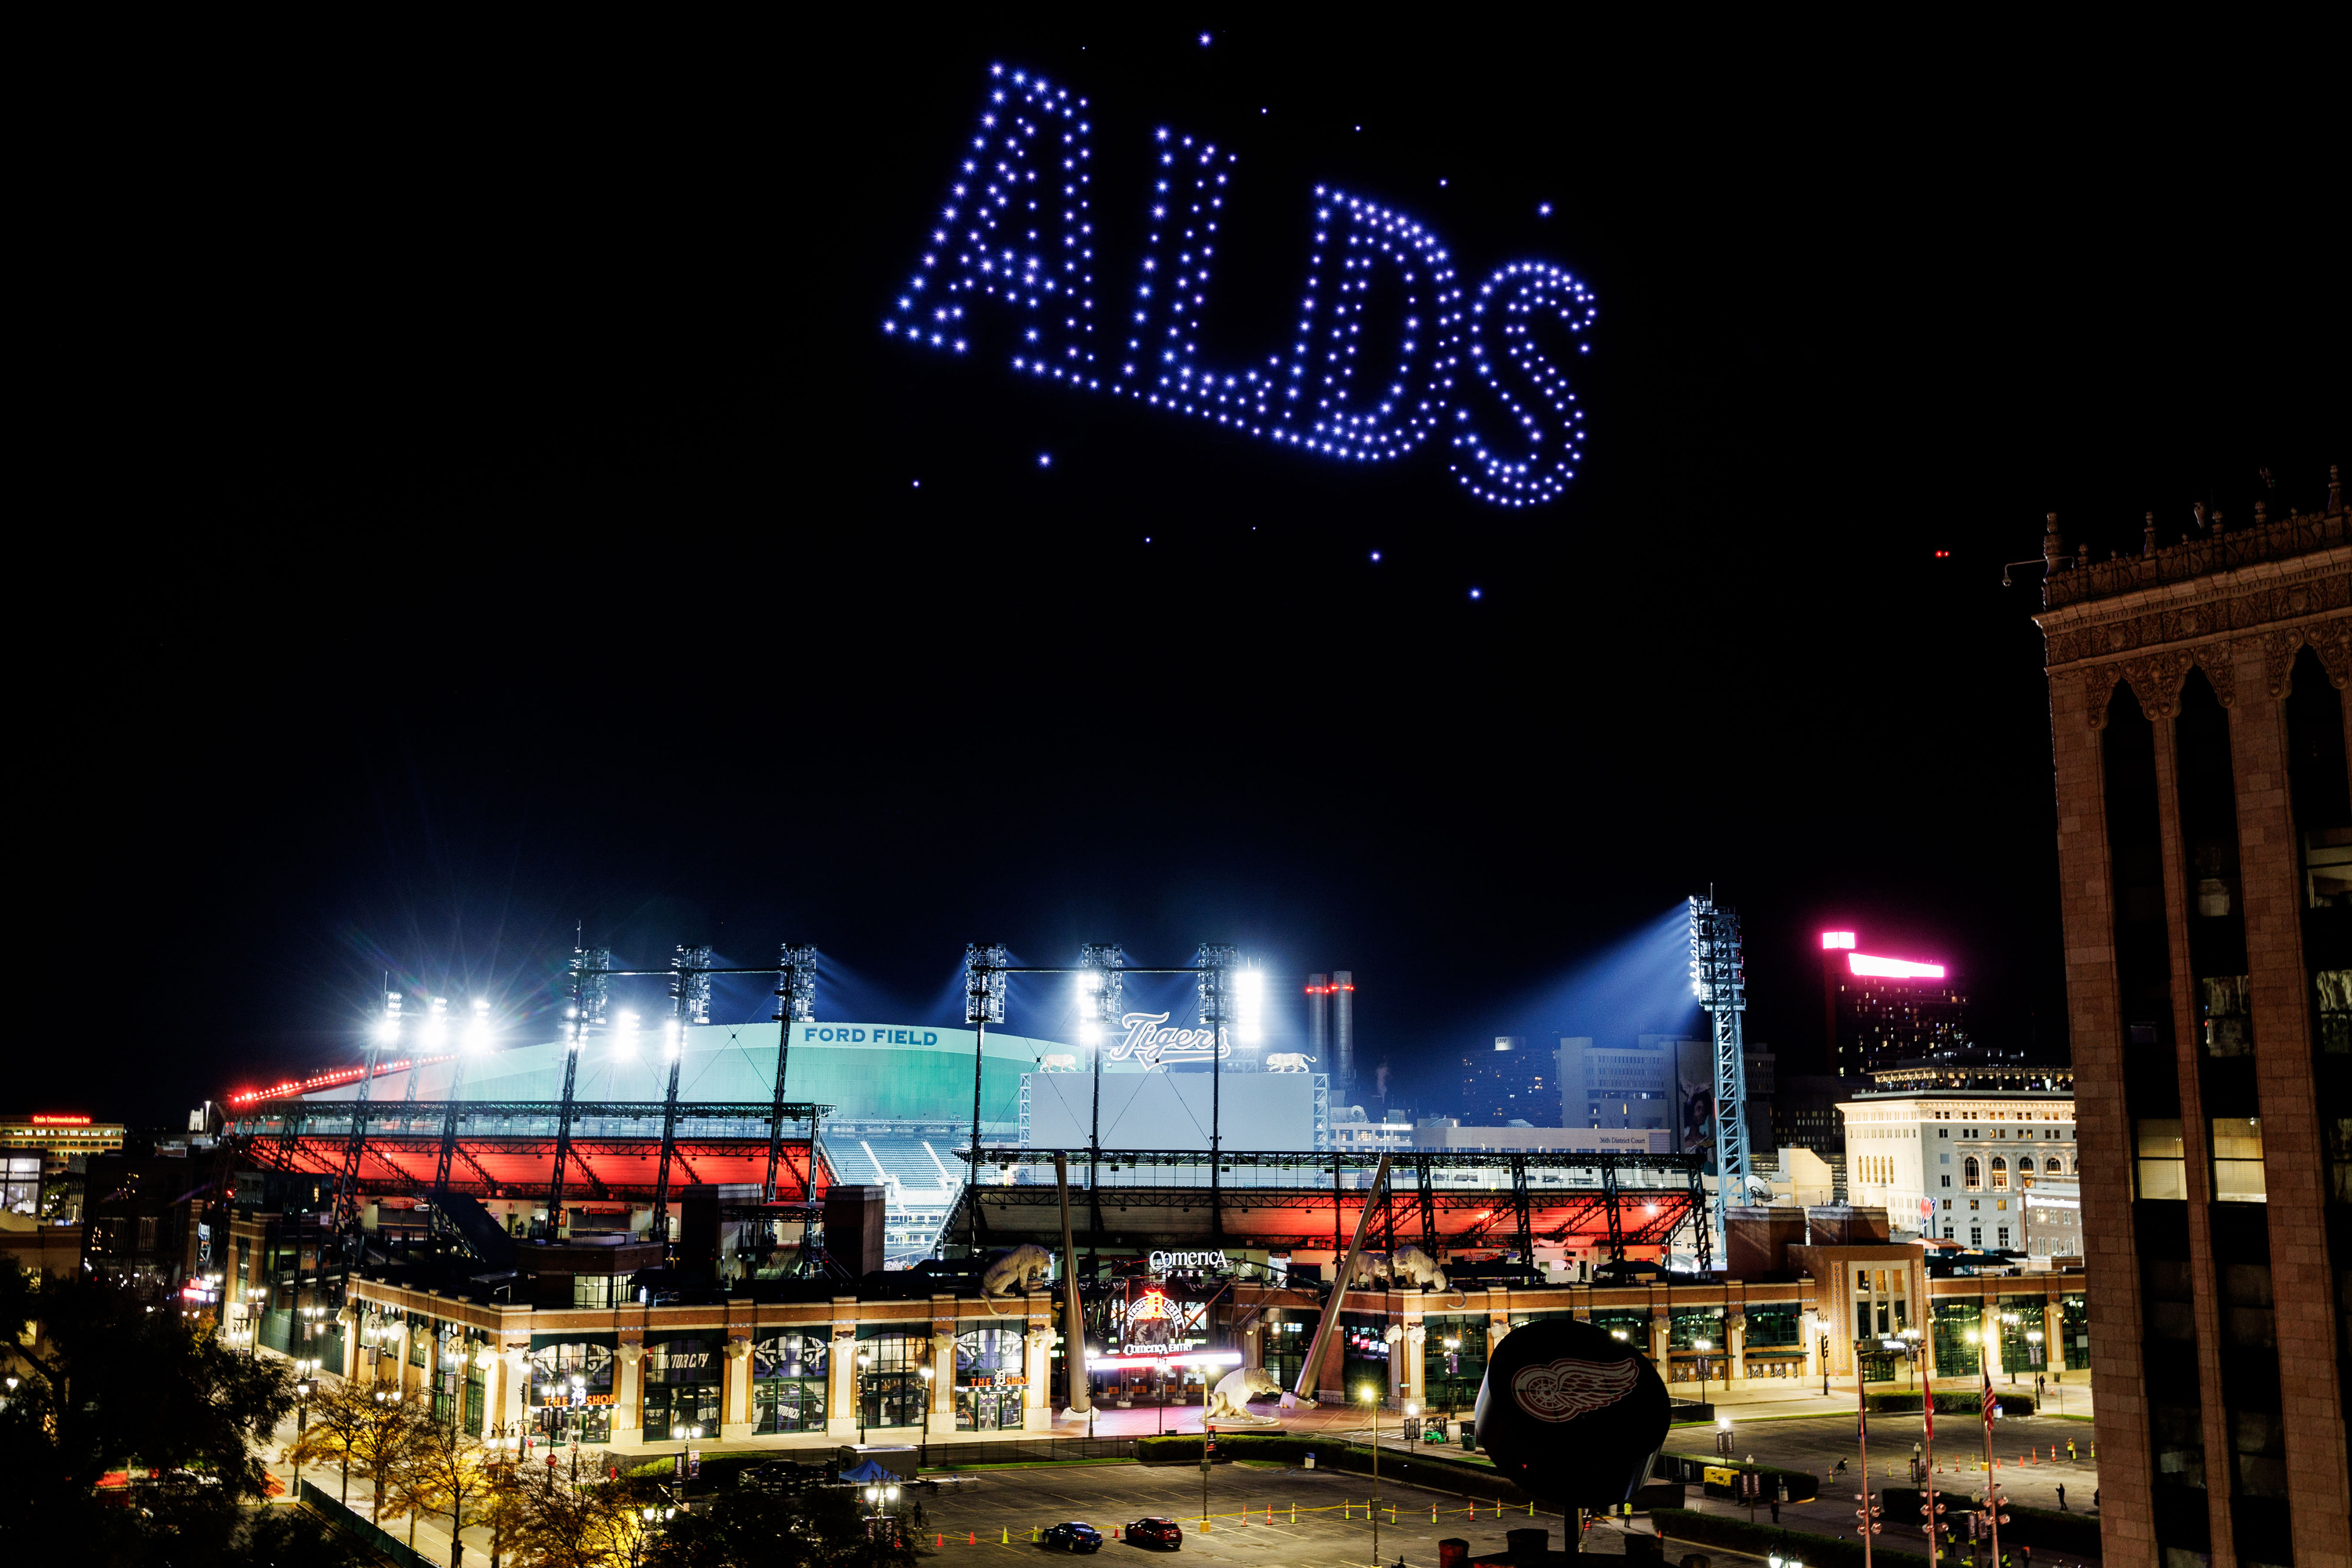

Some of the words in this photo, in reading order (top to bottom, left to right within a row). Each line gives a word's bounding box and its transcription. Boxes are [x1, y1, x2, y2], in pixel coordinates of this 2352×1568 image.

[880, 61, 1598, 507] ALDS
[804, 1027, 866, 1042] FORD
[873, 1029, 938, 1046] FIELD
[1109, 1011, 1231, 1070] Tigers
[47, 1116, 82, 1124] Communications
[1163, 1299, 1184, 1325] TIGERS
[1169, 1343, 1193, 1352] ENTRY
[971, 1377, 991, 1387] THE
[1006, 1376, 1030, 1385] SHOP
[543, 1396, 568, 1407] THE
[586, 1394, 616, 1406] SHOP
